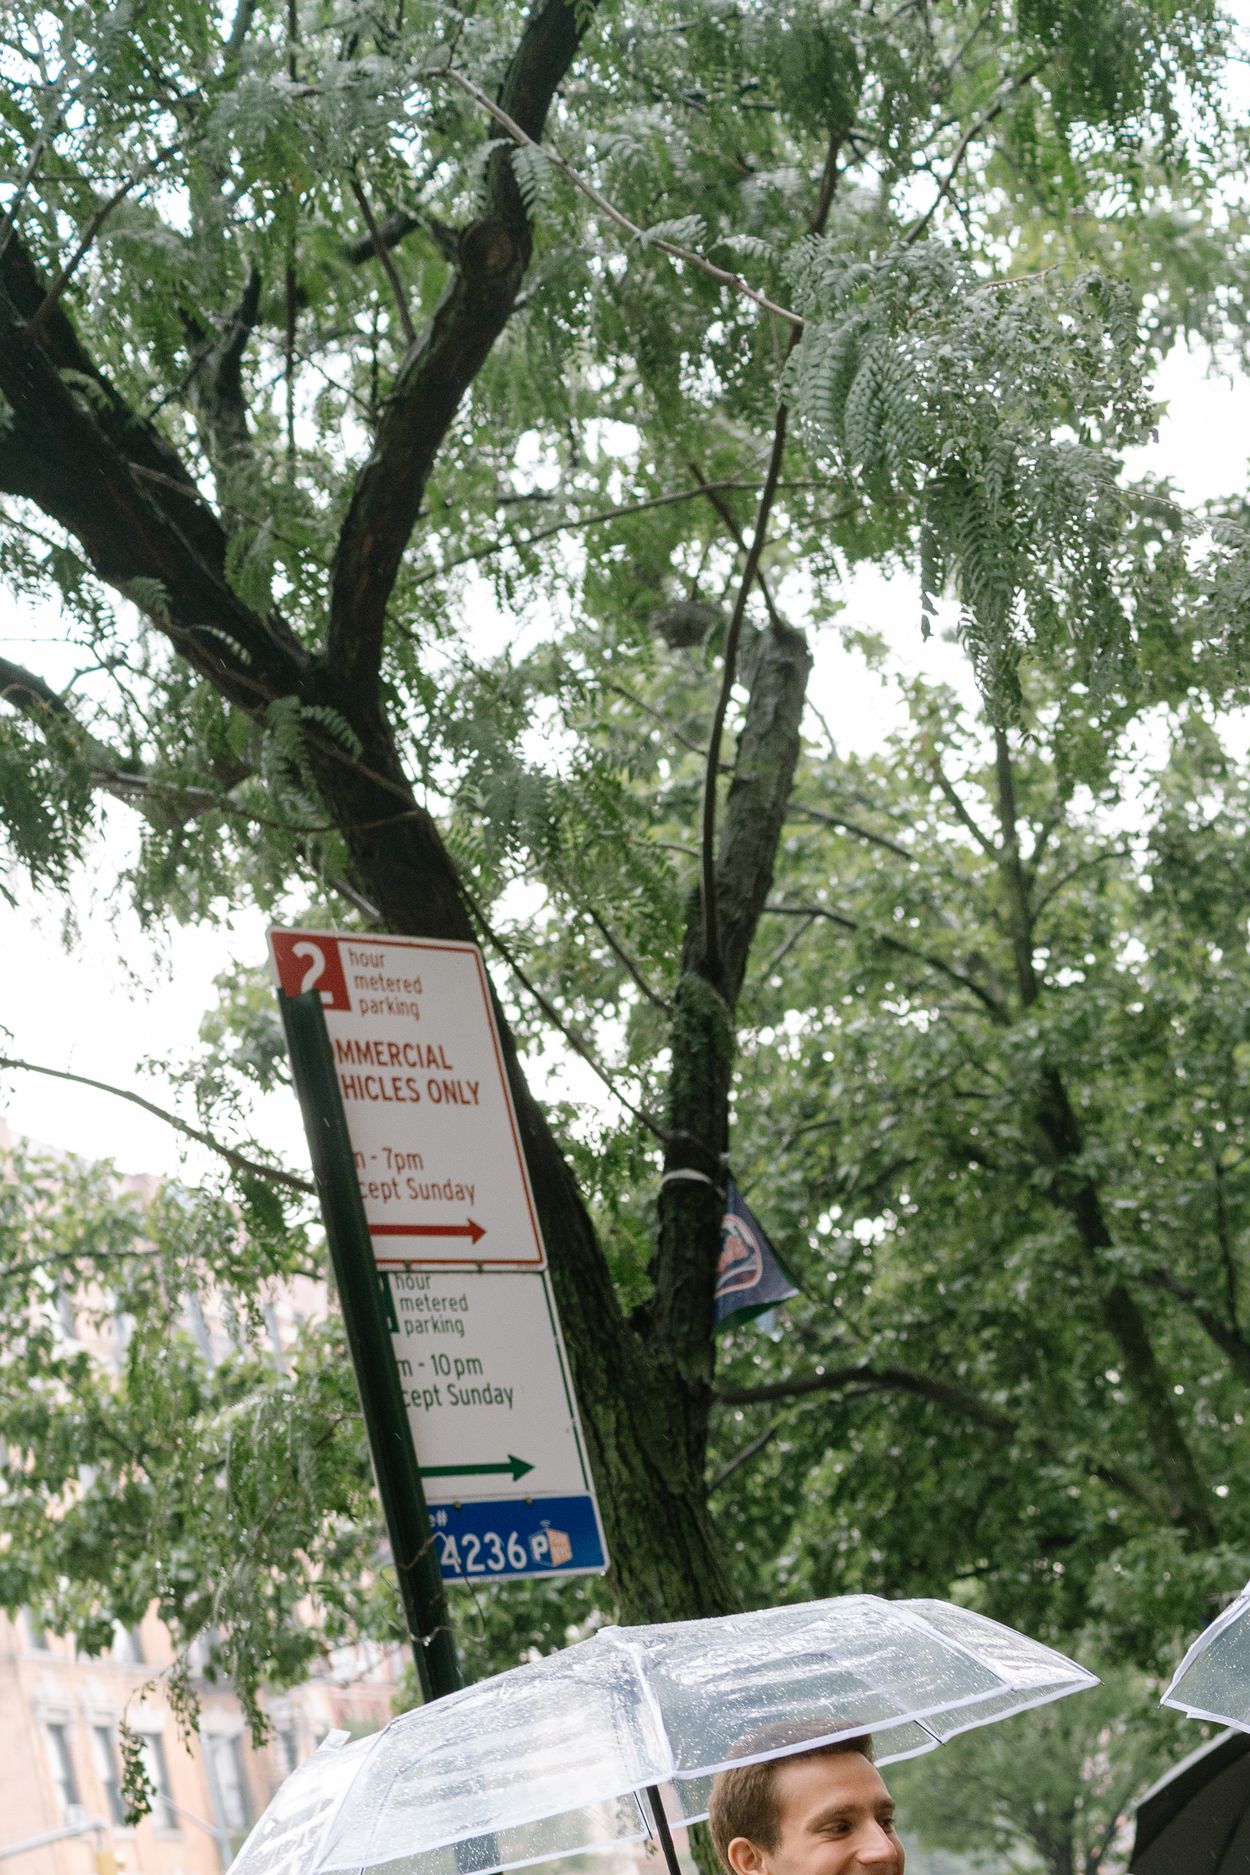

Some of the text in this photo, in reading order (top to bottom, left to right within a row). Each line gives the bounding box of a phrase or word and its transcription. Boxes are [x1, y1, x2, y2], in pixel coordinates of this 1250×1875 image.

[349, 947, 385, 967] hour
[292, 941, 334, 1004] 2
[354, 974, 422, 994] metered
[359, 996, 420, 1021] parking
[334, 1039, 453, 1070] MMERCIAL
[341, 1074, 480, 1105] HICLES ONLY
[382, 1147, 424, 1175] 7pm
[361, 1178, 475, 1206] cept Sunday
[395, 1273, 431, 1290] hour
[400, 1294, 469, 1312] metered
[404, 1315, 465, 1338] parking
[403, 1382, 513, 1412] cept Sunday
[440, 1531, 528, 1574] 4236
